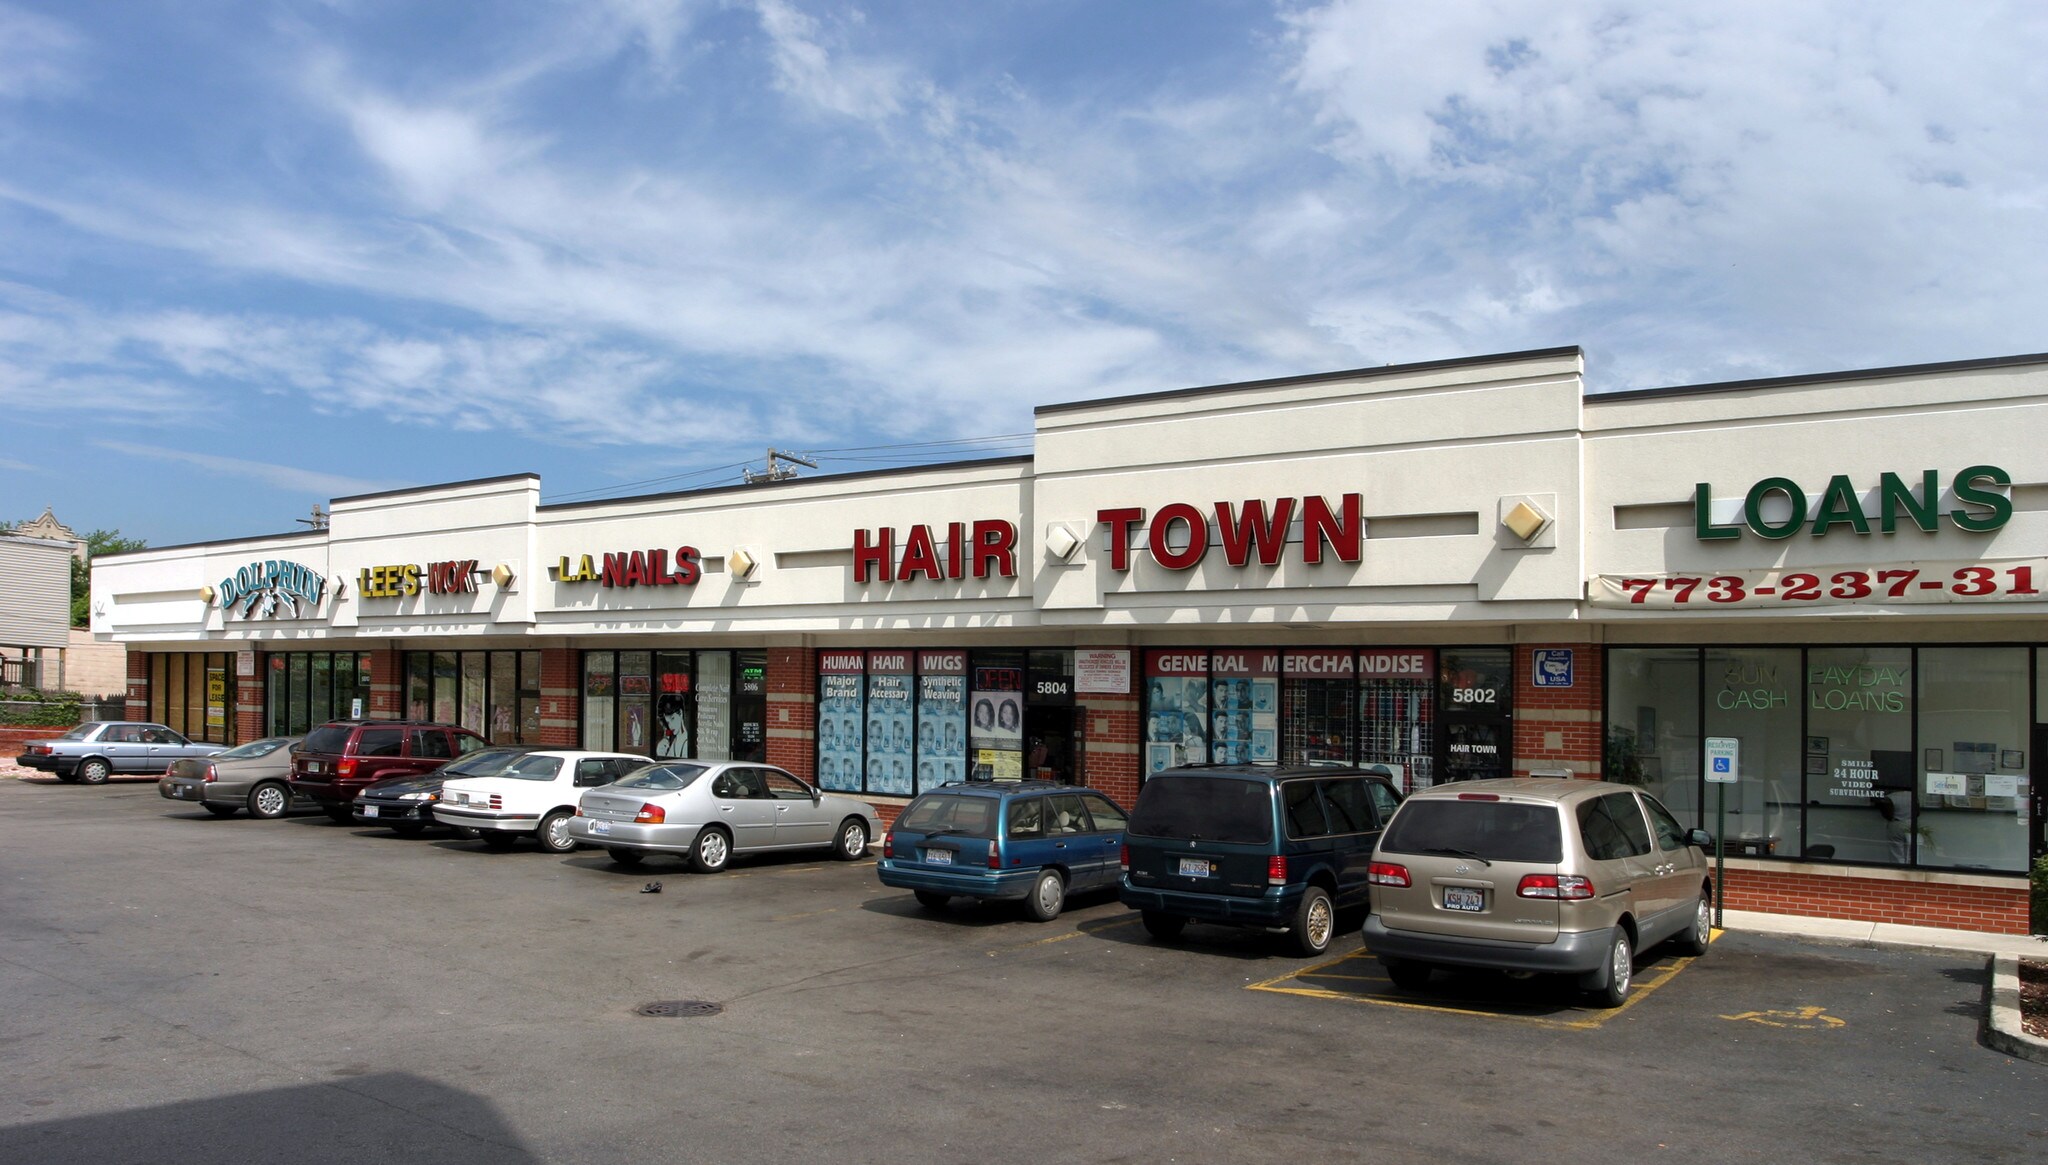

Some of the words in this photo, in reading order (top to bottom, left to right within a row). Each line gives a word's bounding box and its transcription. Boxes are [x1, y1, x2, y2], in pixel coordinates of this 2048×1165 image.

[1695, 464, 2013, 540] LOANS
[853, 518, 1017, 583] HAIR
[1097, 493, 1363, 571] TOWN
[559, 554, 597, 582] L.A.
[603, 545, 701, 588] NAILS
[219, 559, 325, 610] DOLPHIN
[359, 563, 421, 598] LEE'S
[427, 559, 479, 594] WOK
[823, 656, 863, 669] HUMAN
[873, 656, 904, 669] HAIR
[923, 655, 962, 670] WIGS
[1158, 655, 1249, 672] GENERAL
[1262, 655, 1424, 673] MERCHANDISE
[209, 673, 224, 681] SPACE
[1725, 665, 1777, 684] SUN
[1808, 665, 1907, 687] PAYDAY
[743, 683, 758, 691] 5806
[827, 676, 856, 688] Major
[878, 677, 900, 687] Hair
[923, 677, 961, 688] Synthetic
[1037, 682, 1067, 694] 5804
[209, 694, 224, 702] LEASE
[827, 688, 857, 697] Brand
[870, 688, 908, 701] Accessary
[924, 690, 960, 702] Weaving
[1453, 688, 1495, 703] 5802
[1717, 689, 1787, 709] CASH
[1812, 689, 1903, 712] LOANS
[1450, 744, 1470, 753] HAIR
[1471, 745, 1497, 754] TOWN
[1834, 769, 1848, 778] 24
[1850, 769, 1879, 780] HOUR
[1841, 781, 1873, 789] VIDEO
[1829, 788, 1885, 798] SURVEILLANCE
